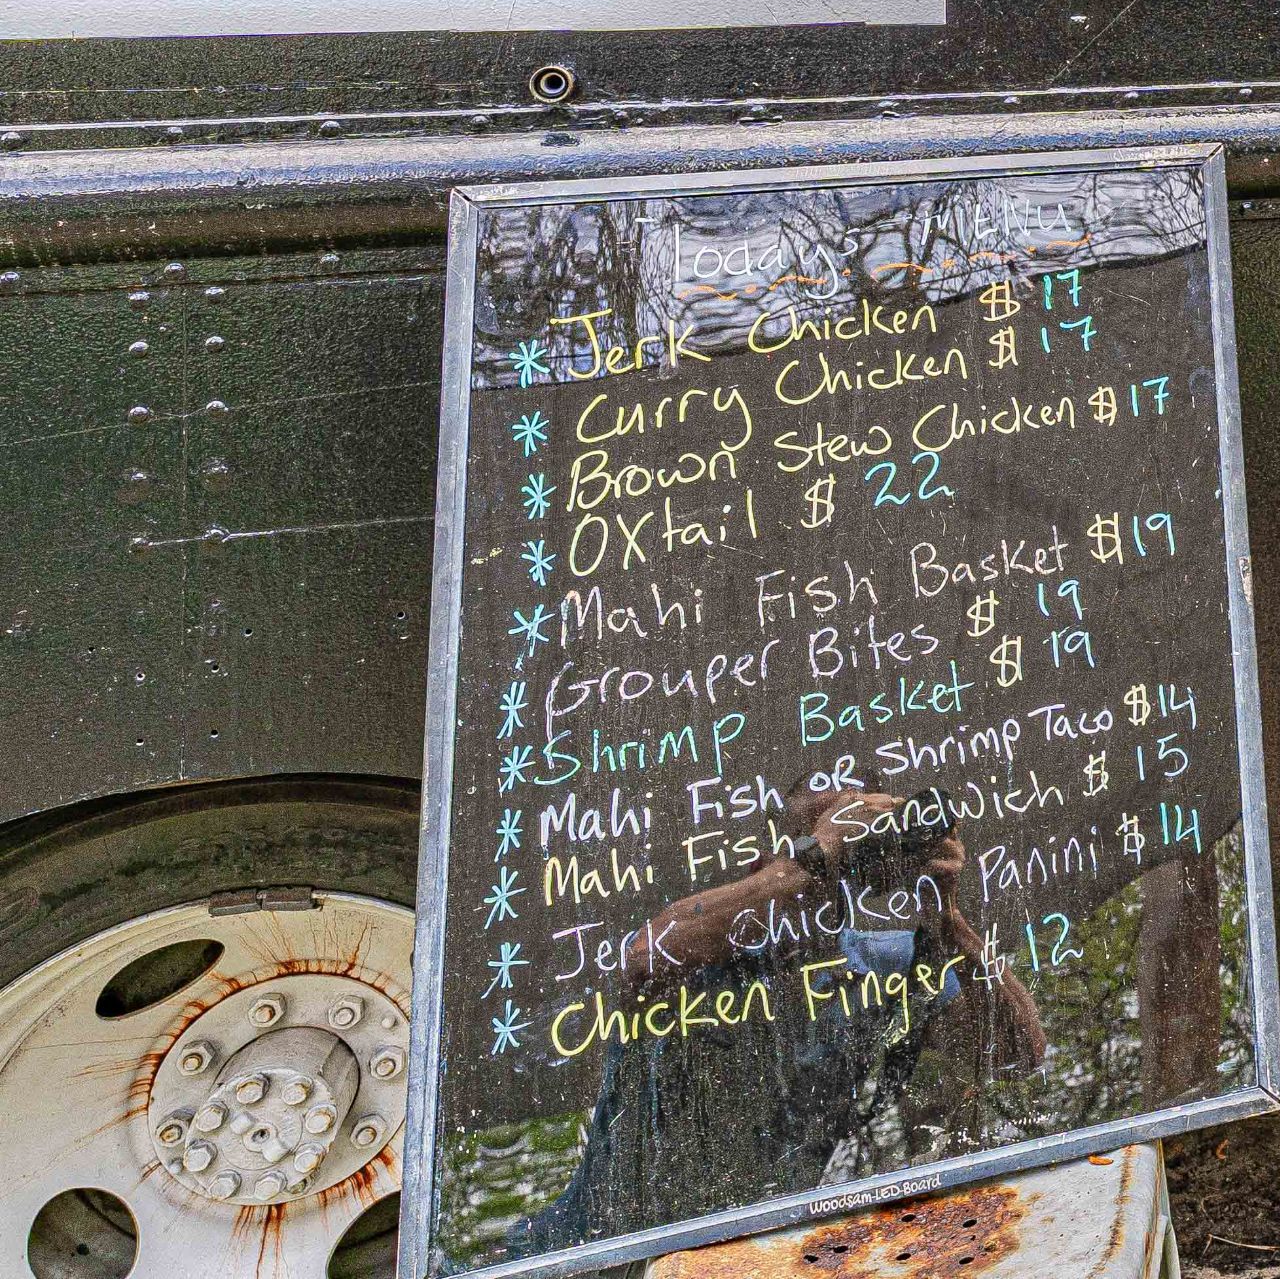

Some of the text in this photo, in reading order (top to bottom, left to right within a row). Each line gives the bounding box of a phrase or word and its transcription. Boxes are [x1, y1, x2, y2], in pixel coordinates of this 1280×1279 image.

[549, 300, 937, 381] Jerk Chicken
[576, 346, 967, 451] Curry Chicken
[566, 447, 736, 513] Brown
[774, 423, 892, 475] Stew
[912, 396, 1075, 454] Chicken
[561, 582, 701, 647] Mahi
[755, 560, 878, 628] Fish
[911, 525, 1068, 597] Basket
[546, 615, 939, 768] Grouper Bites
[800, 660, 975, 746] Basket
[541, 788, 652, 848] Mahi
[688, 775, 783, 823] Fish
[876, 719, 1021, 775] Shrimp
[1028, 704, 1113, 740] Taco
[545, 771, 1064, 906] Mahi Fish Sandwich
[727, 874, 942, 949] Chicken
[979, 826, 1097, 901] Panini
[551, 956, 965, 1056] Chicken Finger
[809, 1174, 941, 1214] Woodsam-LED-Board
